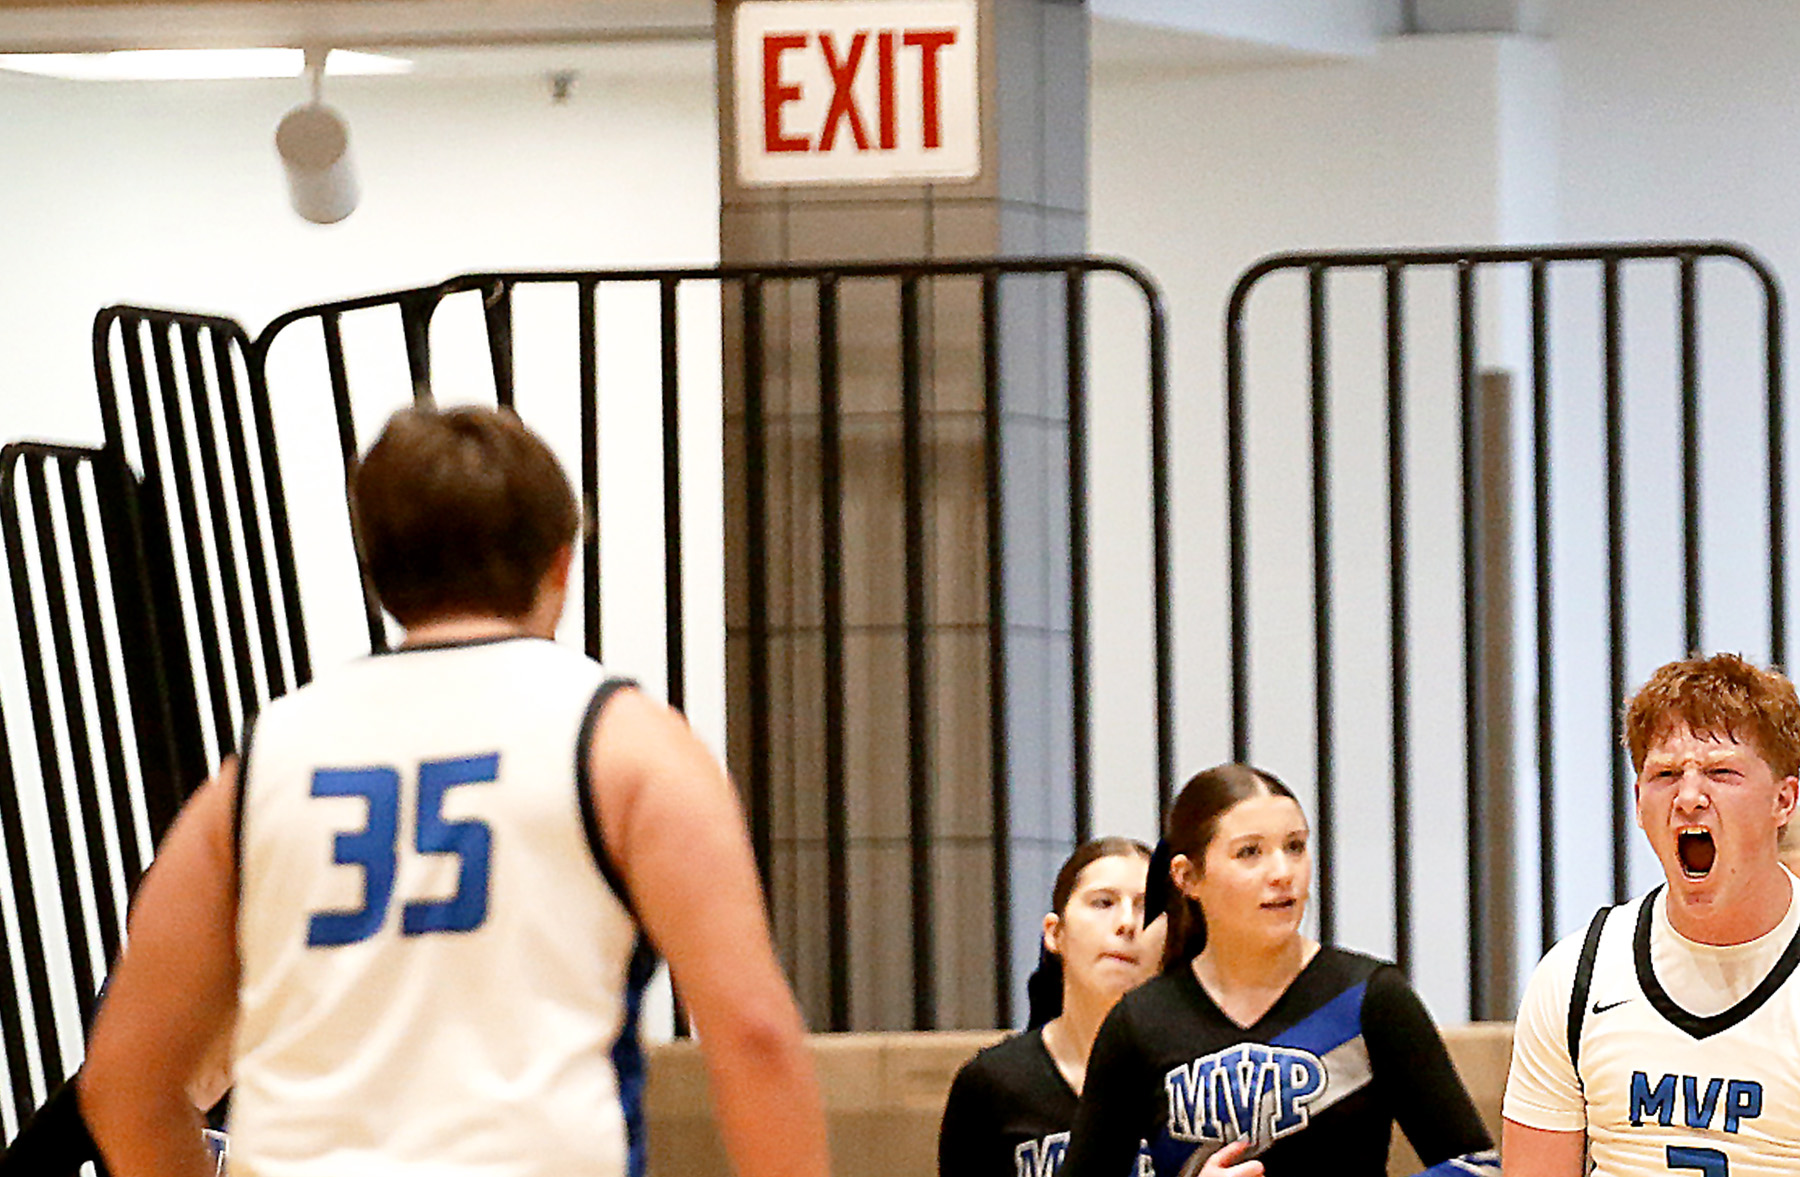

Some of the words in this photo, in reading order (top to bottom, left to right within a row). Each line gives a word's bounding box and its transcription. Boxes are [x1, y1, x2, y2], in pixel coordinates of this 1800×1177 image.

[763, 30, 957, 152] EXIT
[307, 752, 500, 947] 35
[1165, 1042, 1328, 1146] MVP
[1629, 1071, 1763, 1134] MVP
